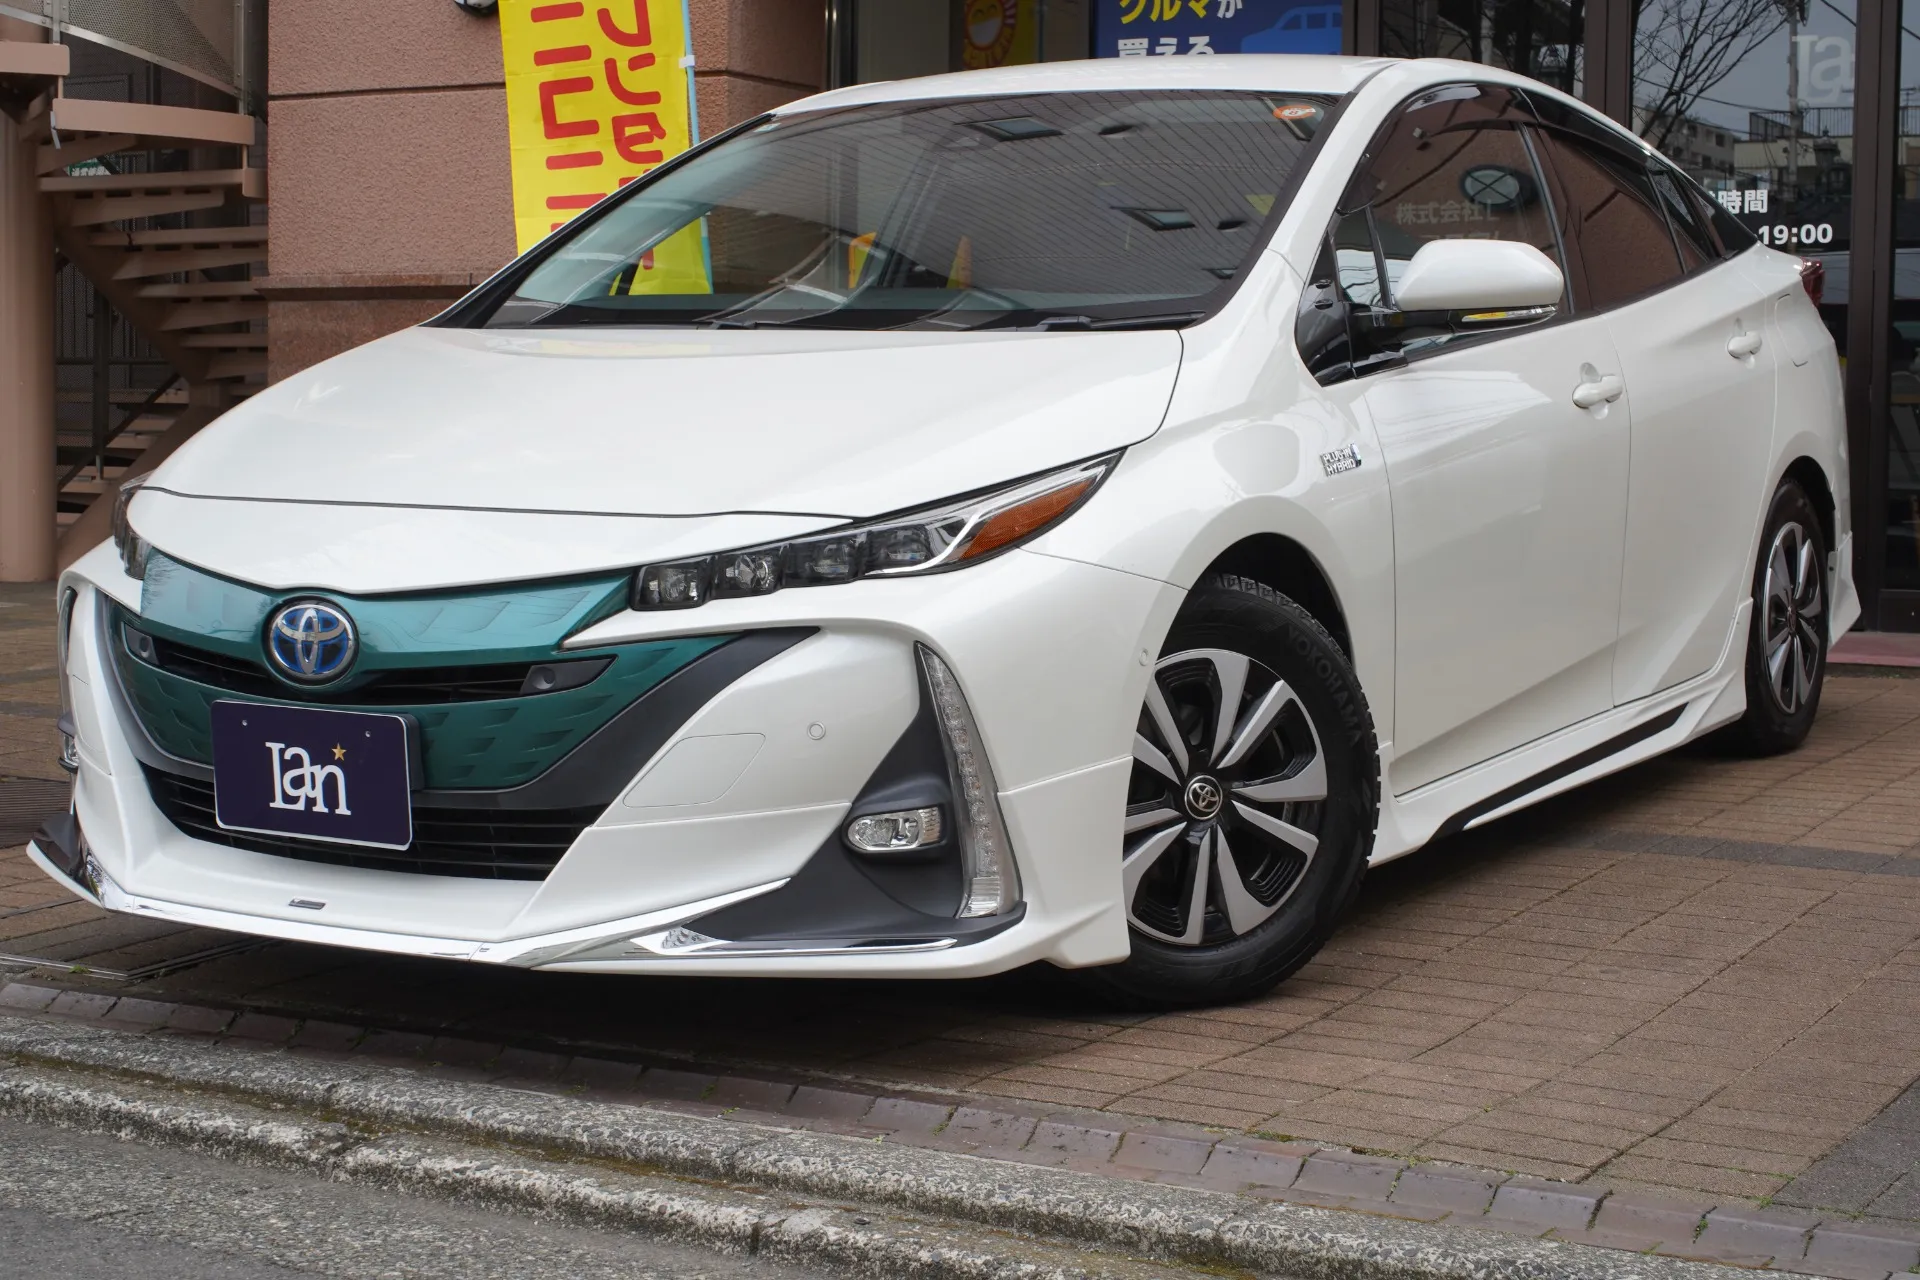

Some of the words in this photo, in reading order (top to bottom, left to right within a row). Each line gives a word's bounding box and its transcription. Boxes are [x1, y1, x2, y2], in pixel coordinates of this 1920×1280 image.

[1709, 190, 1769, 215] 時間
[1758, 223, 1833, 245] 19:00
[1326, 458, 1356, 475] HYBRID
[1287, 622, 1363, 748] YOKOHAMA
